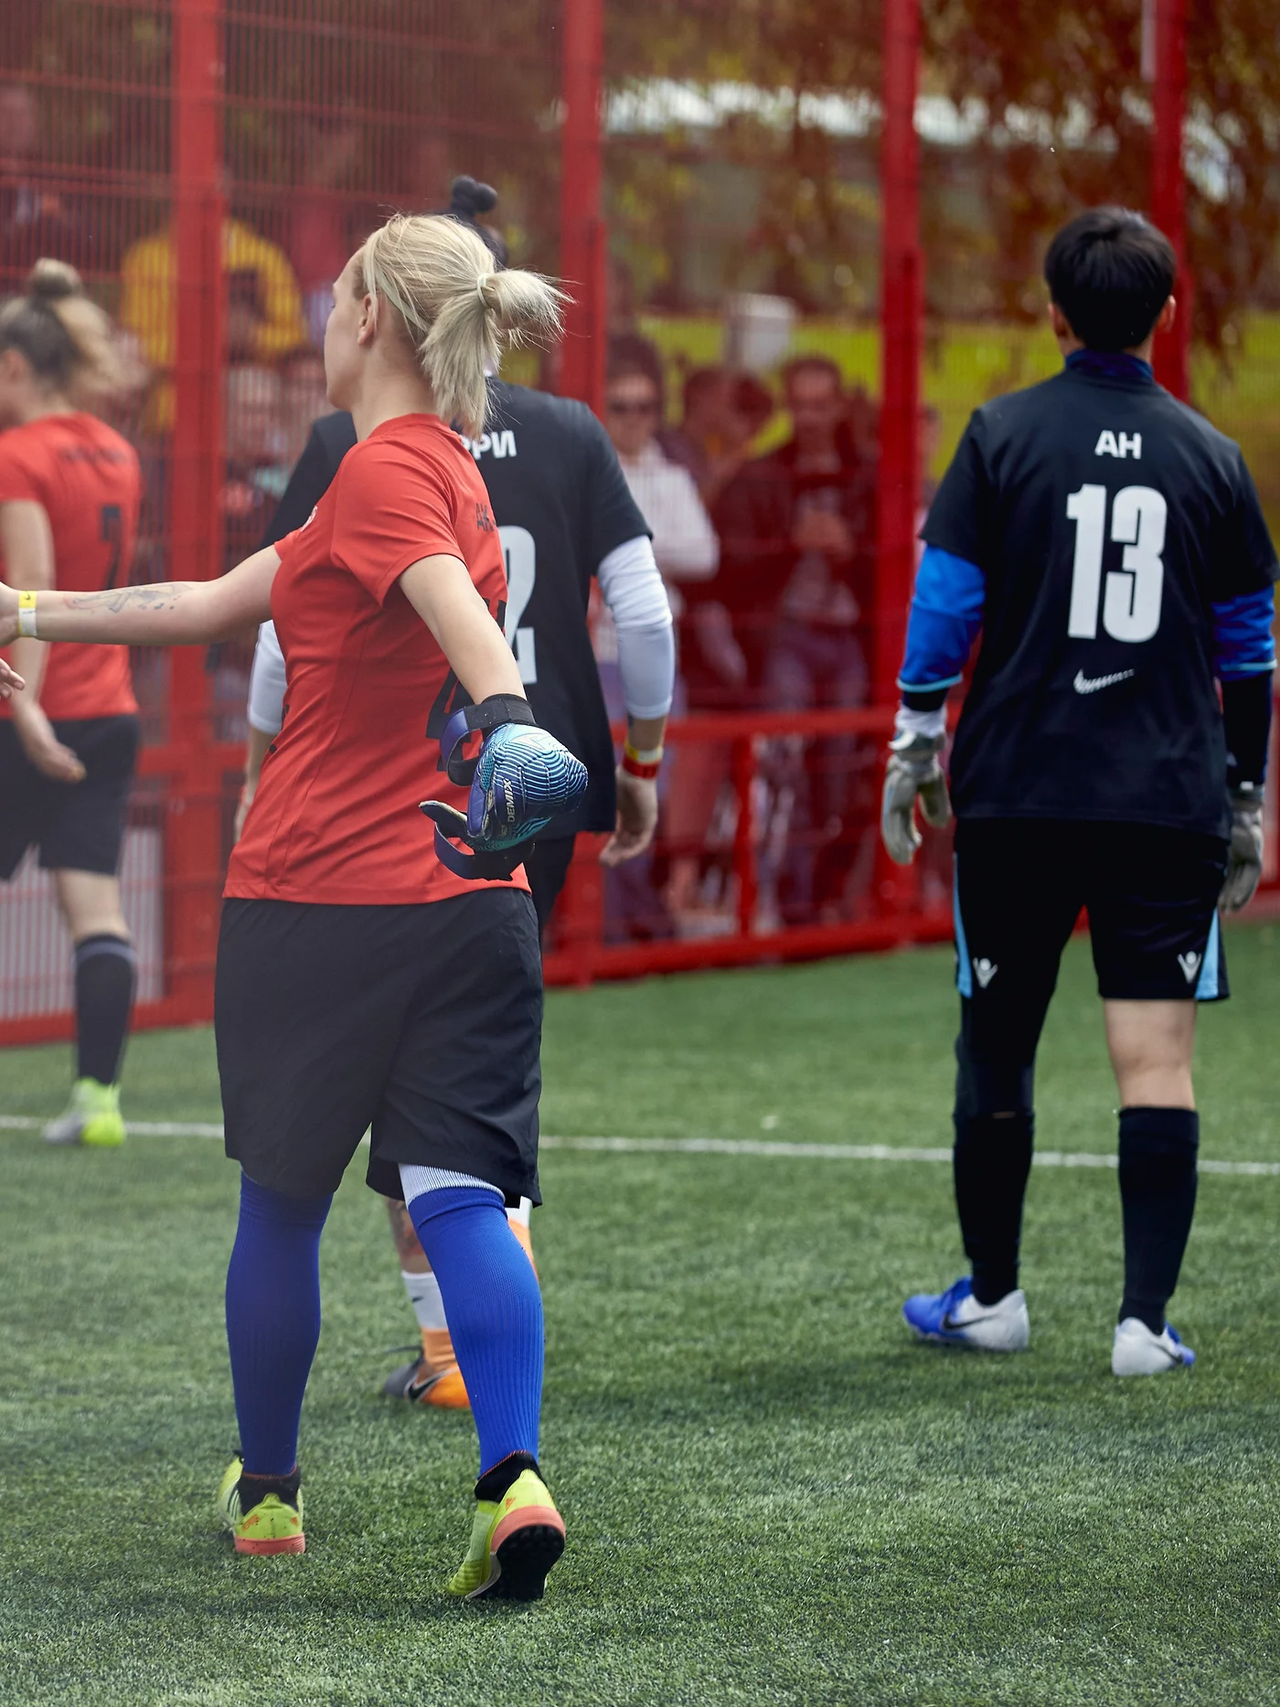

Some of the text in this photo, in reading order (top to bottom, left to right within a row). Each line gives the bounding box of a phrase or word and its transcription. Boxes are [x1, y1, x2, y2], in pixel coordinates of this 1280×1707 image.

[1094, 430, 1142, 460] АН
[1066, 483, 1168, 643] 13
[502, 778, 516, 823] DEMIX
